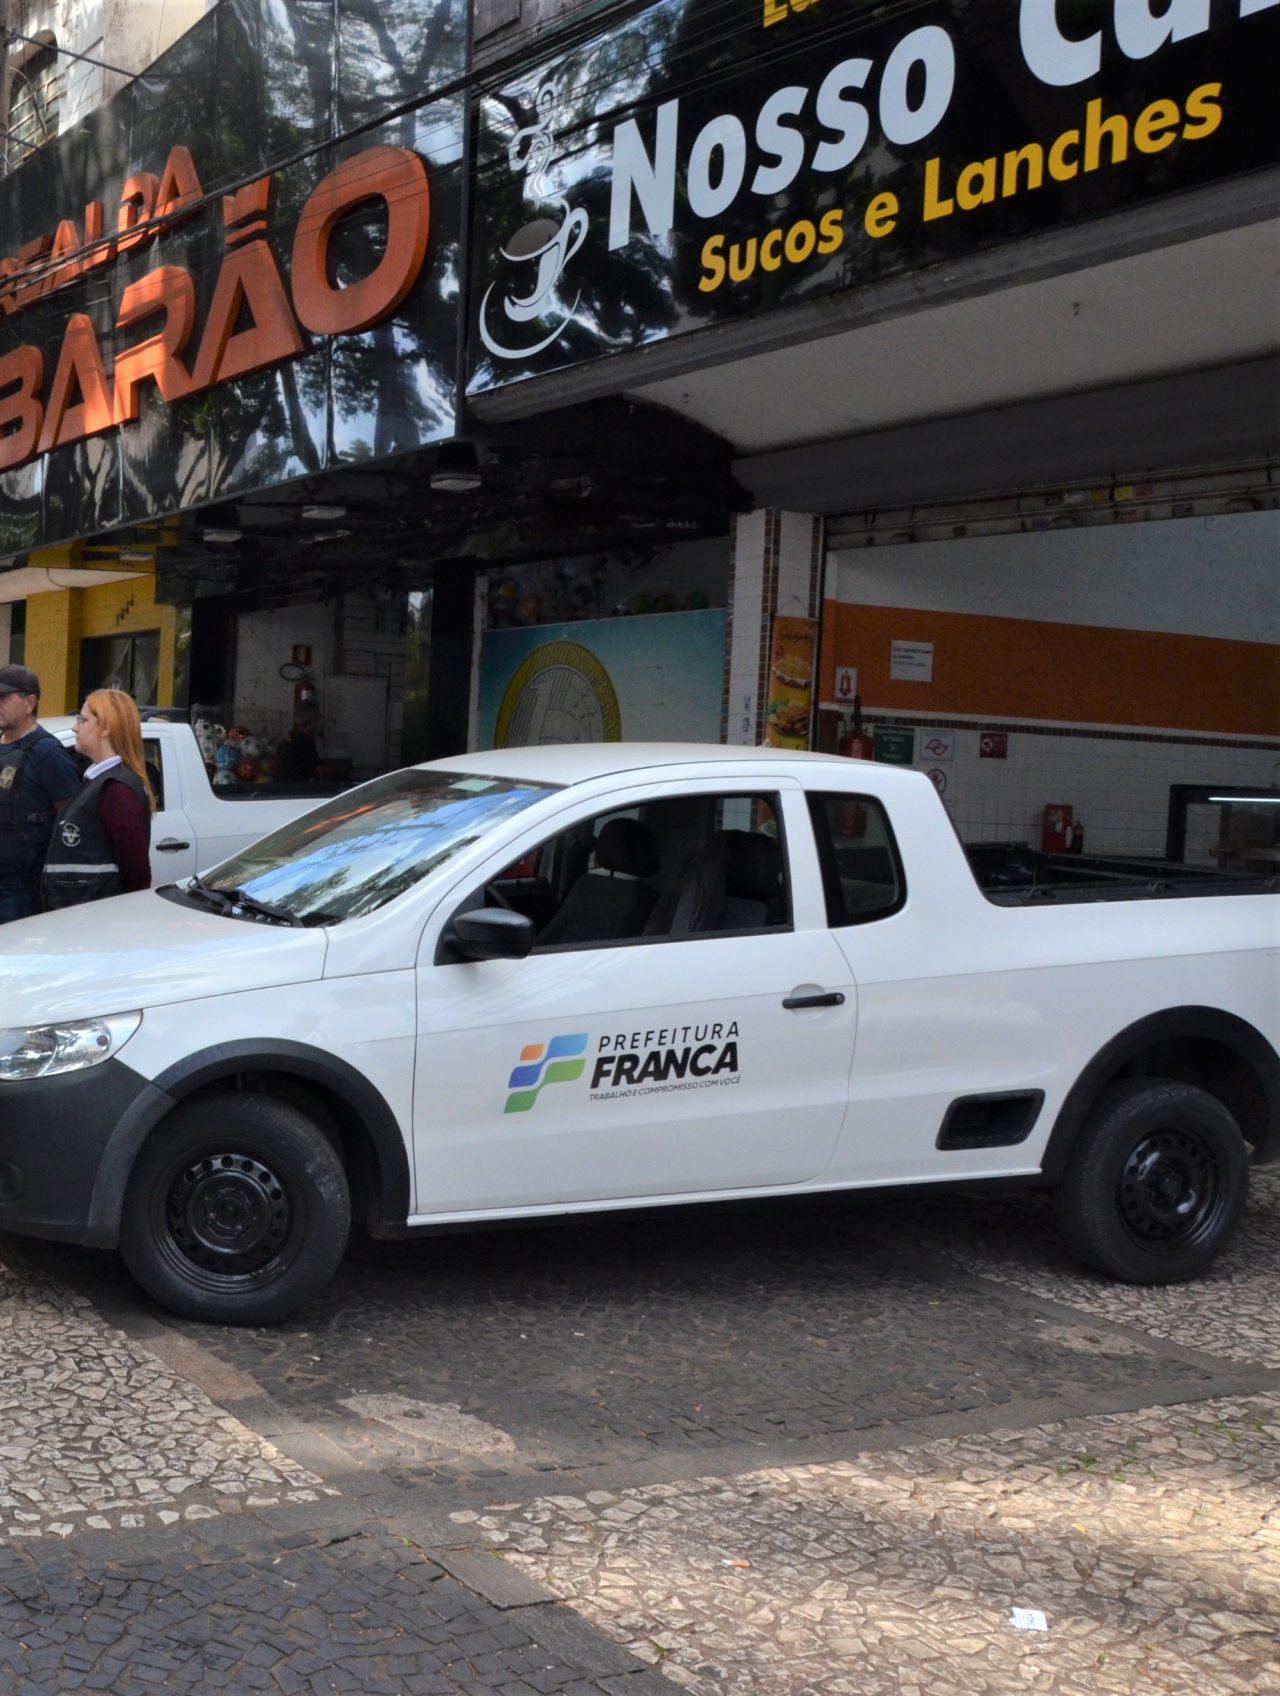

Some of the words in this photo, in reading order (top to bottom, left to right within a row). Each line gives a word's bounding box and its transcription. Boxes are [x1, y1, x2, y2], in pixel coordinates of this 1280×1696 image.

[608, 25, 956, 251] Nosso
[117, 145, 204, 253] DA
[697, 208, 844, 293] Sucos
[864, 191, 900, 239] e
[923, 82, 1223, 223] Lanches
[590, 1041, 739, 1089] FRANCA
[598, 1021, 739, 1053] PREFEITURA
[589, 1089, 632, 1101] TRABALHO
[632, 1088, 638, 1097] E
[638, 1081, 699, 1096] COMPROMISSO
[699, 1078, 719, 1088] COM
